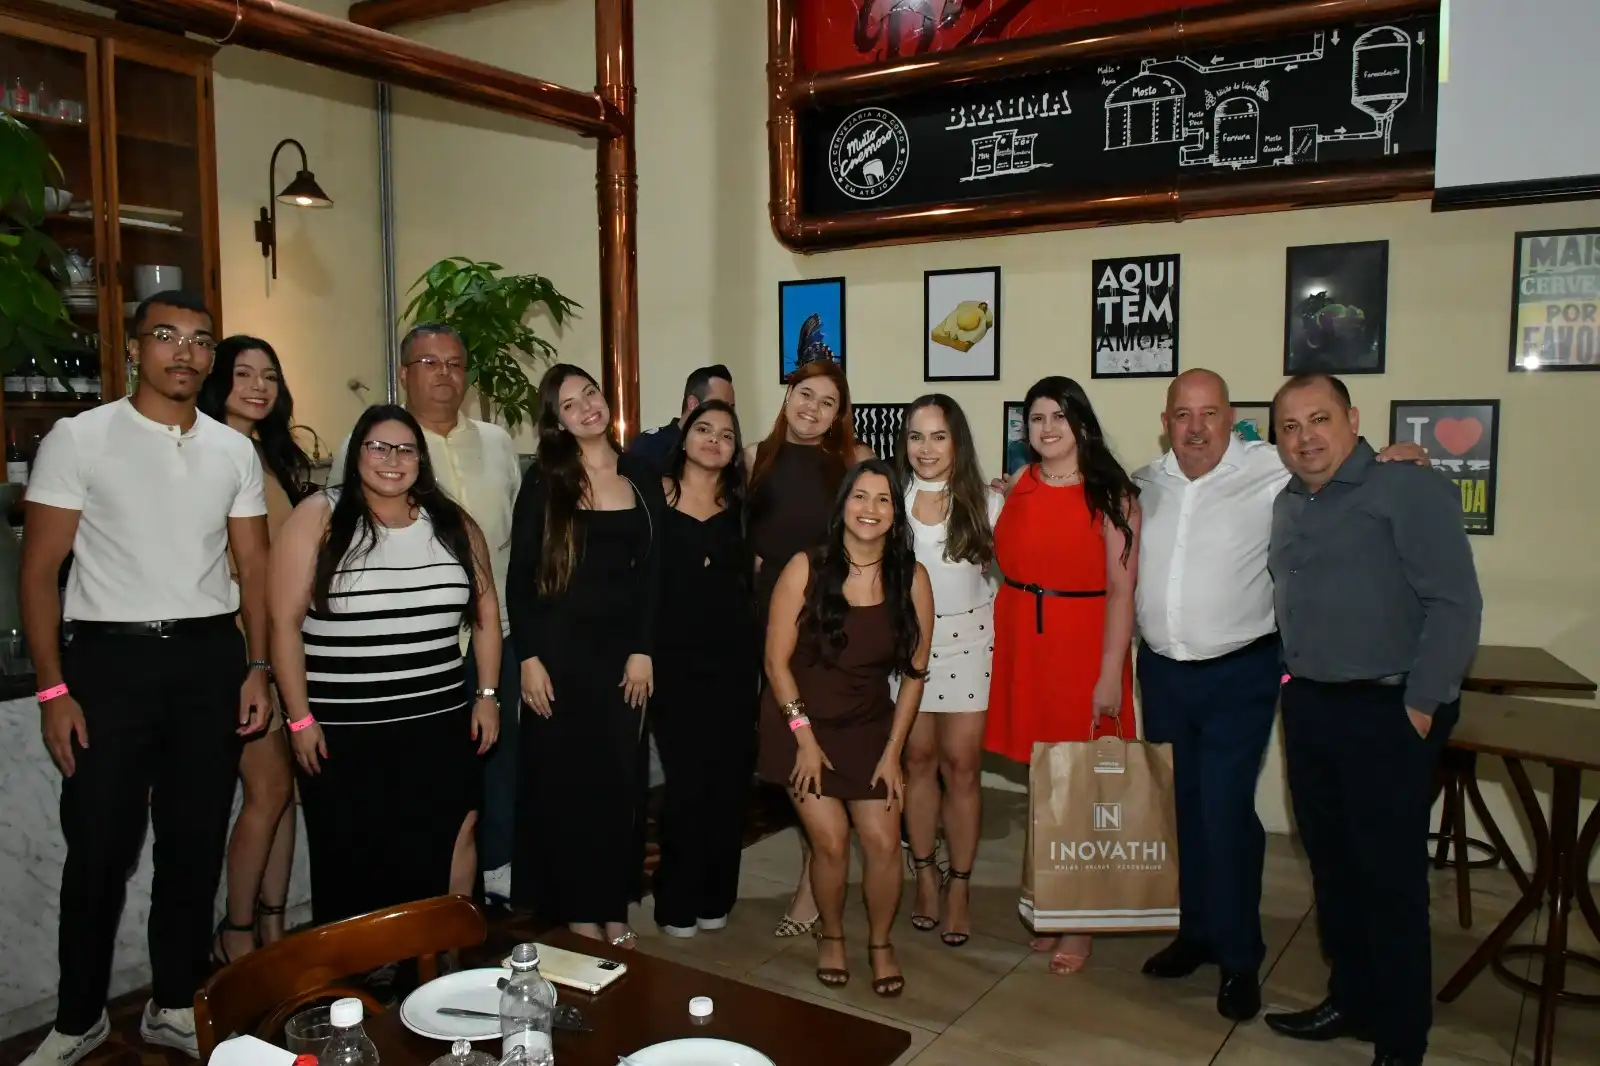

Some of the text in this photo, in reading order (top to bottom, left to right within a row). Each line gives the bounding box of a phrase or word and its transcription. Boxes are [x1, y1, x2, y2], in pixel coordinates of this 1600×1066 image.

[1132, 85, 1157, 97] Mosto
[945, 90, 1072, 131] BRAHMA
[832, 111, 872, 155] CERVEJARIA
[889, 119, 905, 142] COPO
[846, 124, 884, 157] Muito
[1222, 132, 1251, 142] Fervura
[1264, 134, 1282, 142] Mosto
[840, 128, 894, 177] Cremoso
[1097, 261, 1175, 294] AQUI
[1520, 275, 1600, 296] CERVE
[1096, 292, 1174, 324] TEM
[1546, 303, 1598, 323] POR
[1523, 325, 1600, 365] FAVO
[1095, 805, 1119, 829] IN
[1050, 840, 1166, 861] INOVATHI
